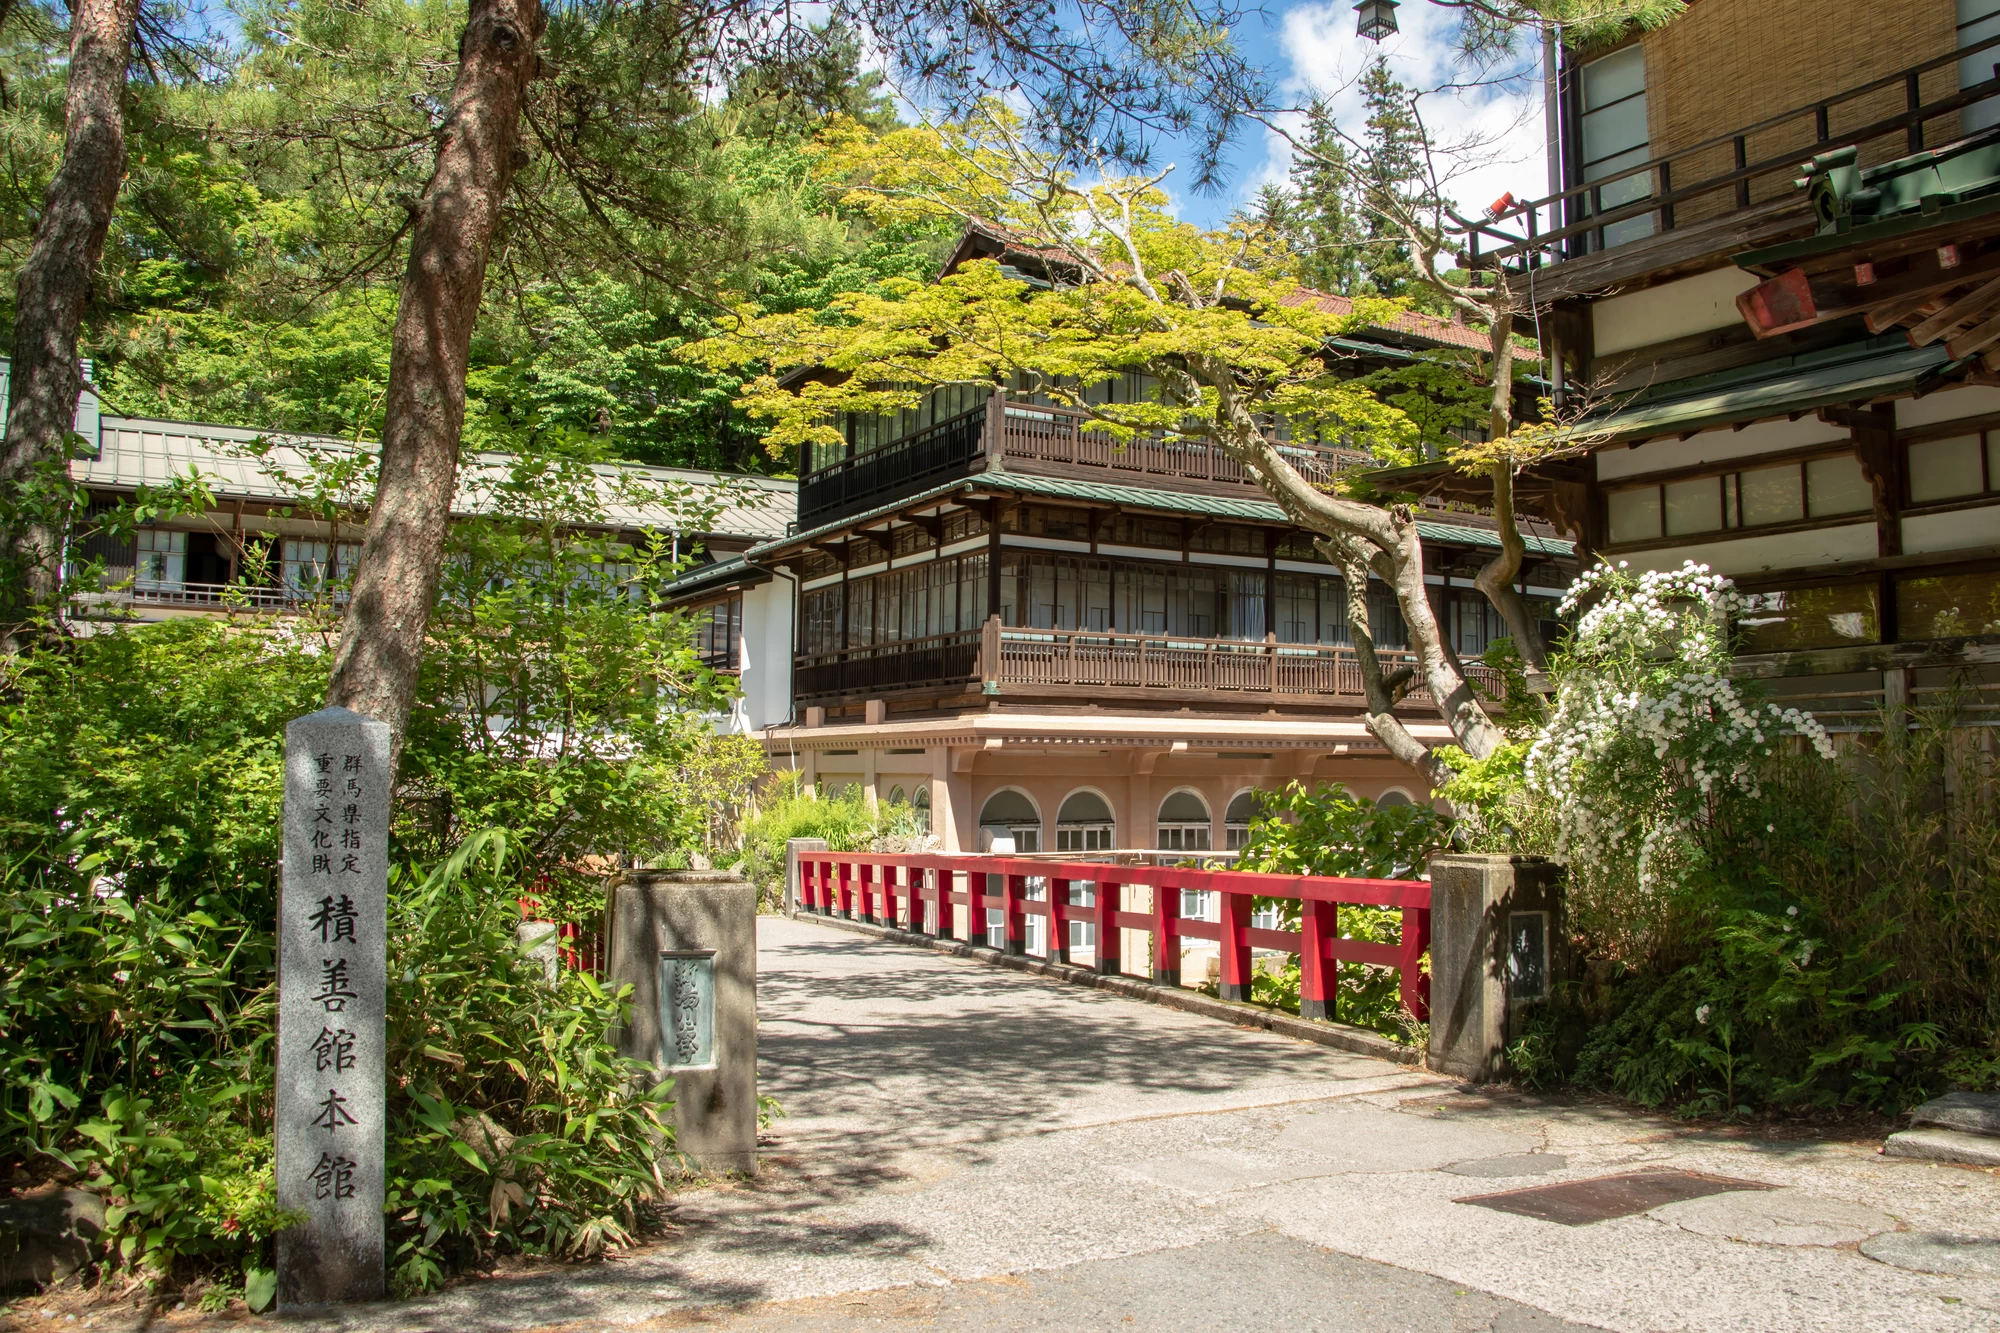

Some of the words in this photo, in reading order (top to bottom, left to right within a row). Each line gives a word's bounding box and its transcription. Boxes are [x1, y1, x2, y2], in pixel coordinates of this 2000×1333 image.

[310, 752, 334, 875] 重要文化財
[340, 754, 363, 874] 群馬県指定
[306, 893, 360, 1201] 積善館本館
